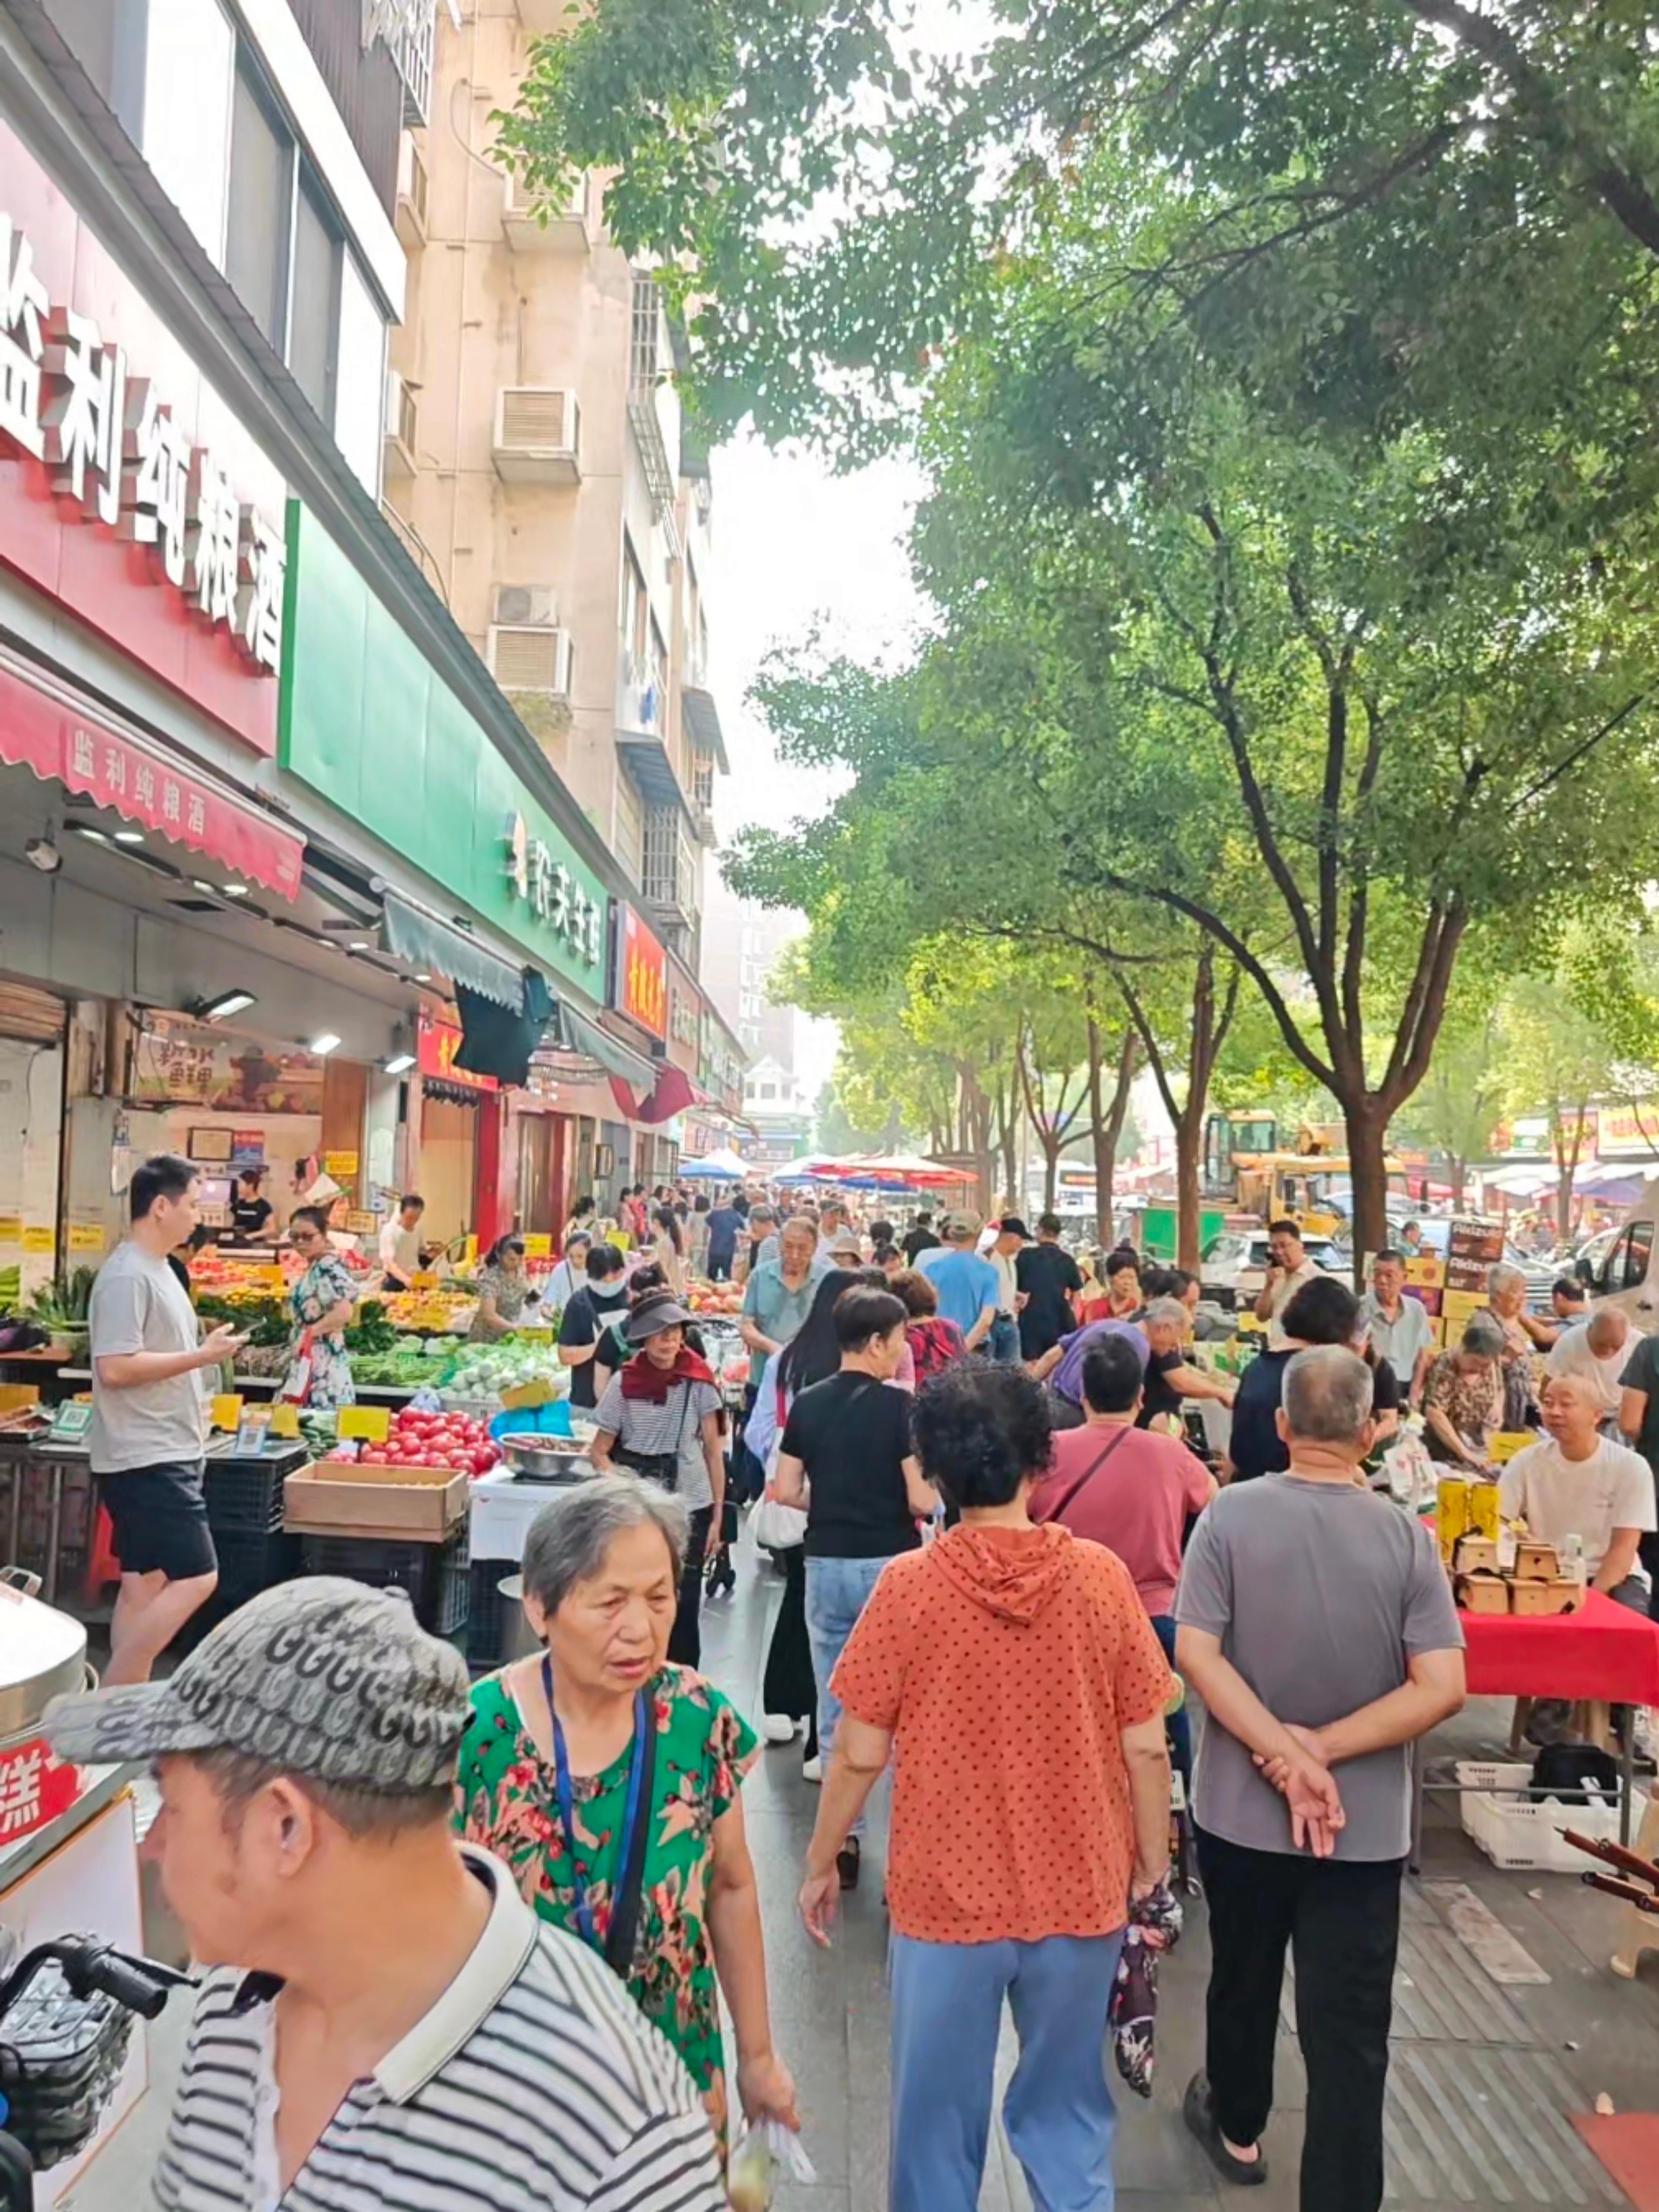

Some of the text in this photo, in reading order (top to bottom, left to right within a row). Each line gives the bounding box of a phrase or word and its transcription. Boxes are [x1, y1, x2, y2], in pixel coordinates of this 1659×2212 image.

[72, 729, 205, 837] 监利纯粮酒
